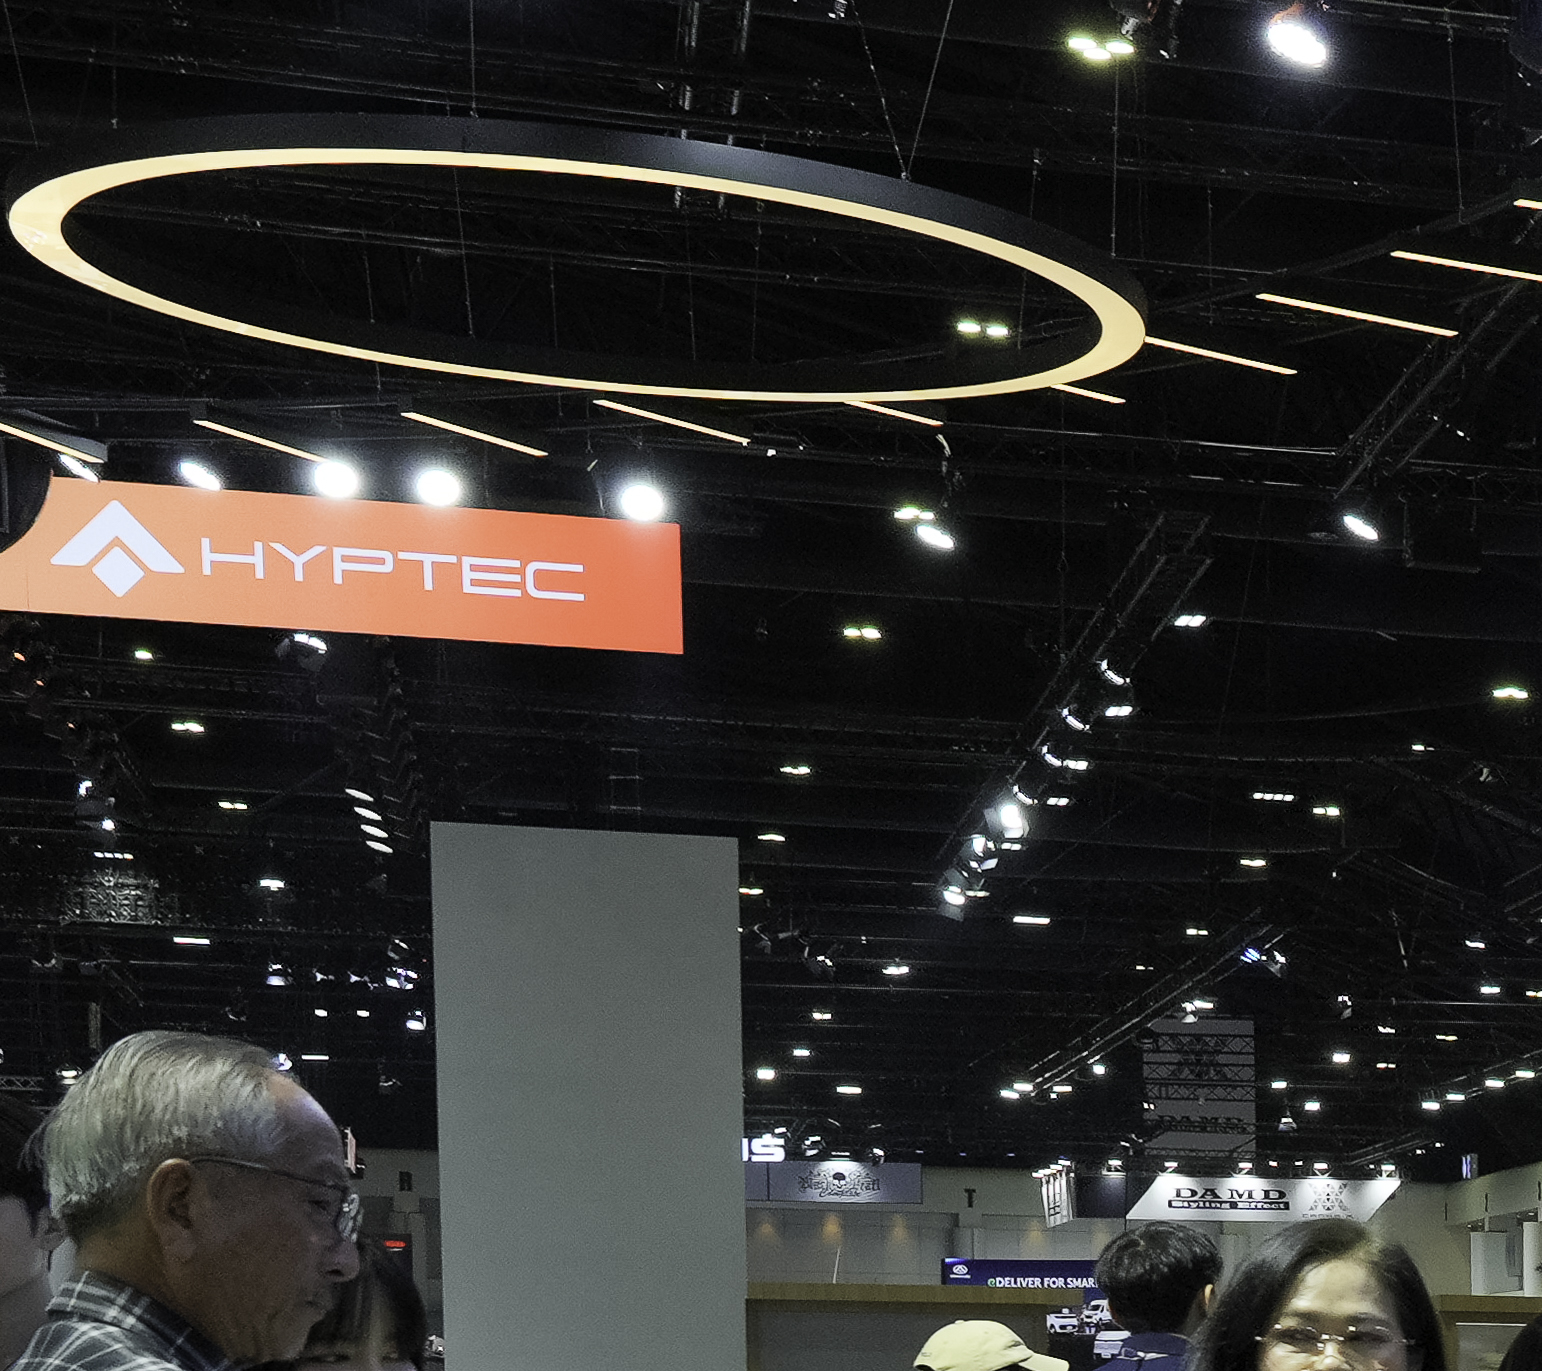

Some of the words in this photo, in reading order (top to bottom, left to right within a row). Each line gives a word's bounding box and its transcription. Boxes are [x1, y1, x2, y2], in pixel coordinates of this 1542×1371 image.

[201, 537, 586, 602] HYPTEC
[1174, 1187, 1287, 1200] DAMD
[987, 1277, 1042, 1289] eDELIVER
[1044, 1277, 1065, 1289] FOR
